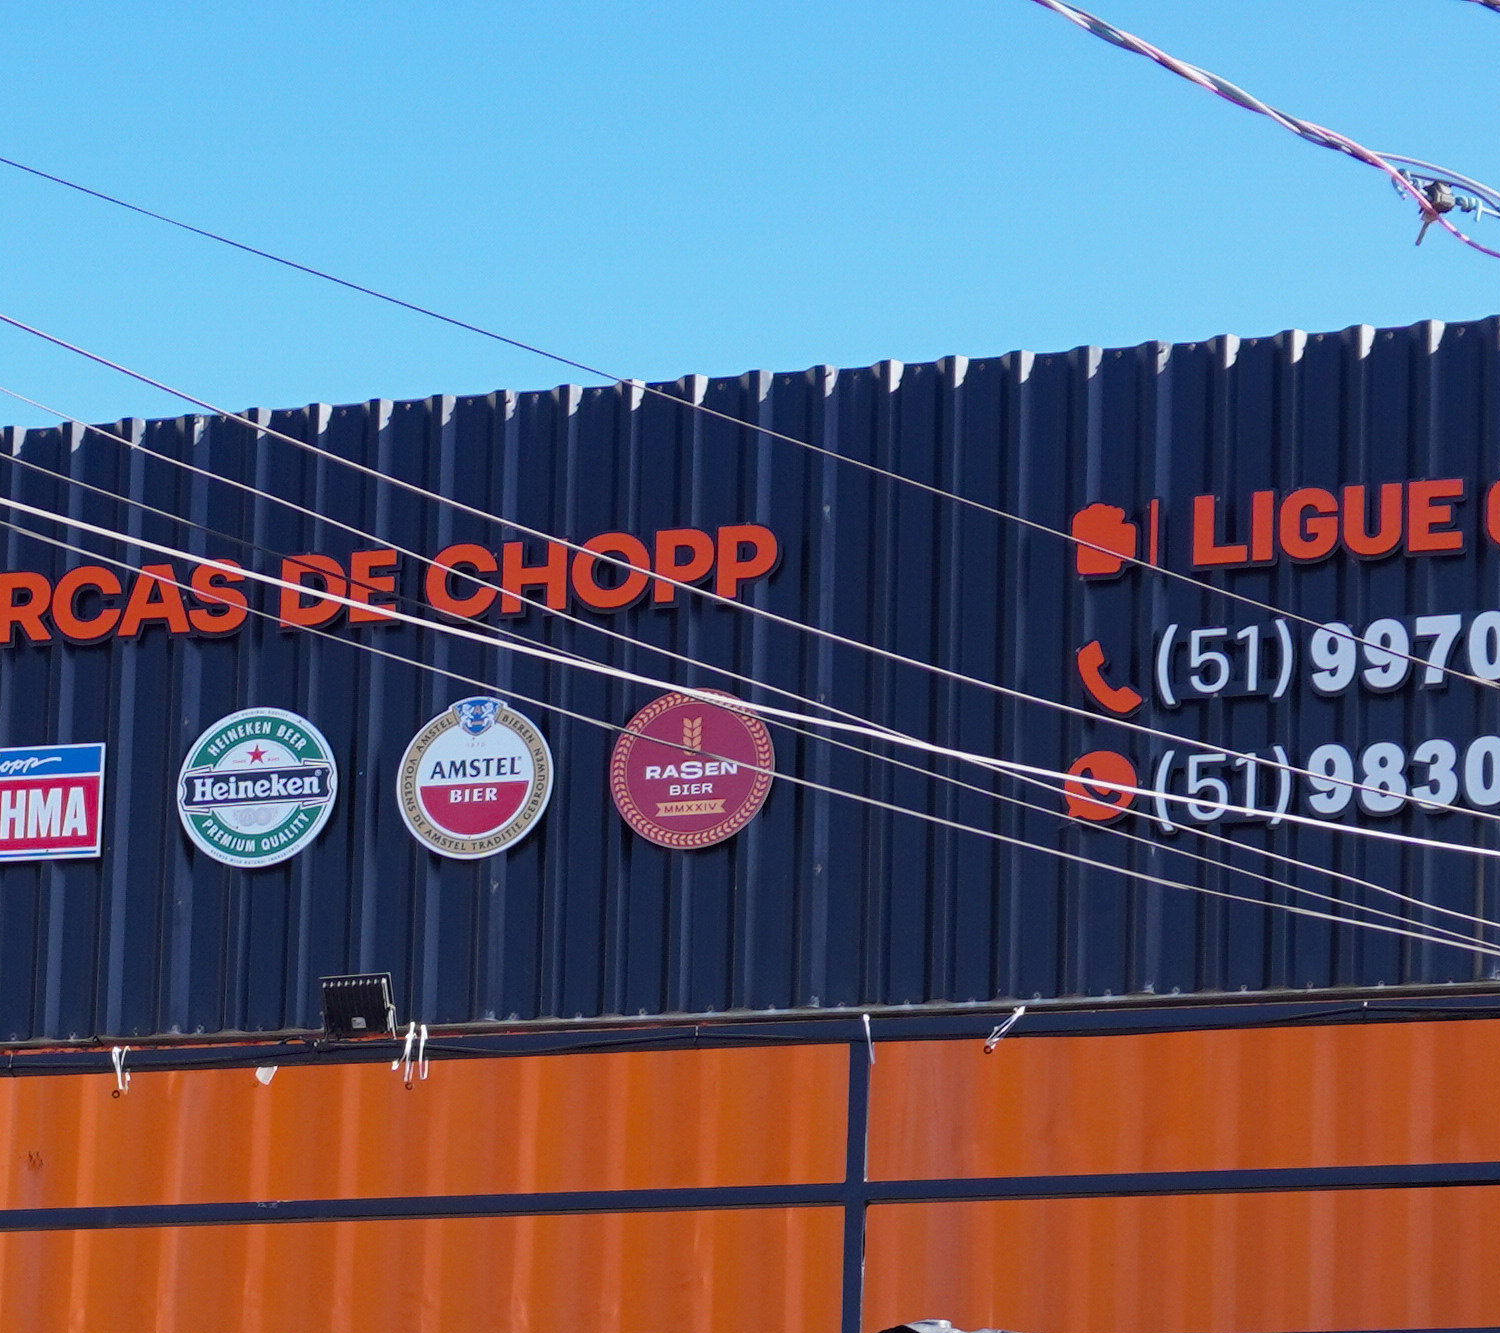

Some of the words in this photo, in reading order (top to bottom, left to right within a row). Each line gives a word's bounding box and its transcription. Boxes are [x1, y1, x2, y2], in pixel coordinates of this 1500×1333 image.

[1190, 477, 1465, 566] LIGUE
[280, 548, 399, 629] DE
[424, 522, 781, 619] CHOPP
[1156, 618, 1295, 707] (51)
[207, 721, 272, 757] HEINEKEN
[276, 724, 307, 750] BEER
[416, 717, 453, 752] AMSTEL
[502, 714, 535, 744] BIEREN
[430, 756, 521, 780] AMSTEL
[645, 761, 738, 780] RASEN
[193, 773, 321, 802] Heineken
[404, 758, 417, 813] VOLGENS
[413, 814, 426, 829] DE
[425, 829, 466, 851] AMSTEL
[471, 823, 523, 851] TRADITIE
[523, 747, 546, 820] GEBROUWEN
[450, 787, 498, 804] BIER
[669, 782, 713, 796] BIER
[1152, 745, 1292, 833] (51)
[664, 802, 717, 814] MMXXIV
[202, 818, 256, 852] PREMIUM
[261, 812, 310, 851] QUALITY
